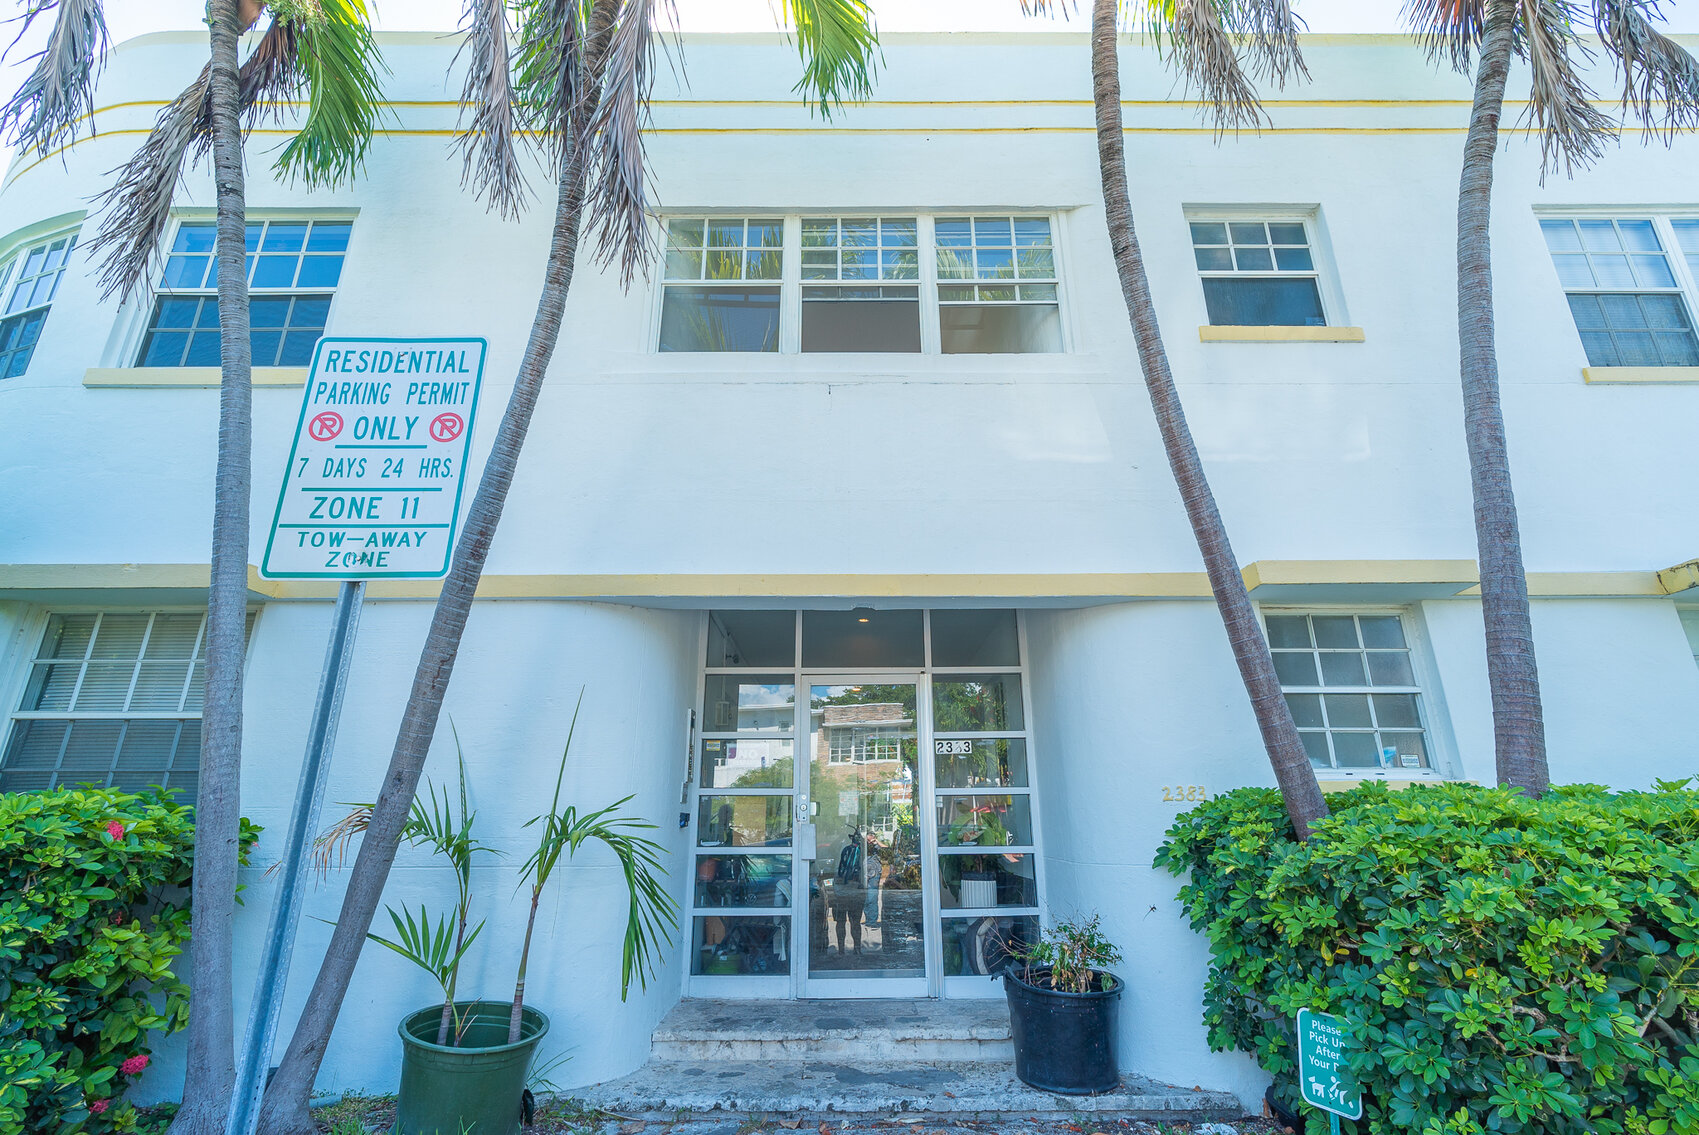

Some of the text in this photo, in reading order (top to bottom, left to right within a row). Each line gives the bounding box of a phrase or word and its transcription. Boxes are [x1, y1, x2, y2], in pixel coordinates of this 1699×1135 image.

[324, 350, 470, 374] RESIDENTIAL
[314, 381, 470, 405] PARKING PERMIT
[353, 416, 419, 440] ONLY
[298, 457, 454, 478] 7 DAYS 24 HRS.
[309, 496, 420, 520] ZONE 11
[325, 551, 390, 568] ZONE
[1162, 785, 1206, 802] 2383
[1311, 1019, 1342, 1036] Please
[1309, 1031, 1329, 1045] Pick
[1315, 1045, 1341, 1061] After
[1308, 1054, 1331, 1071] Your
